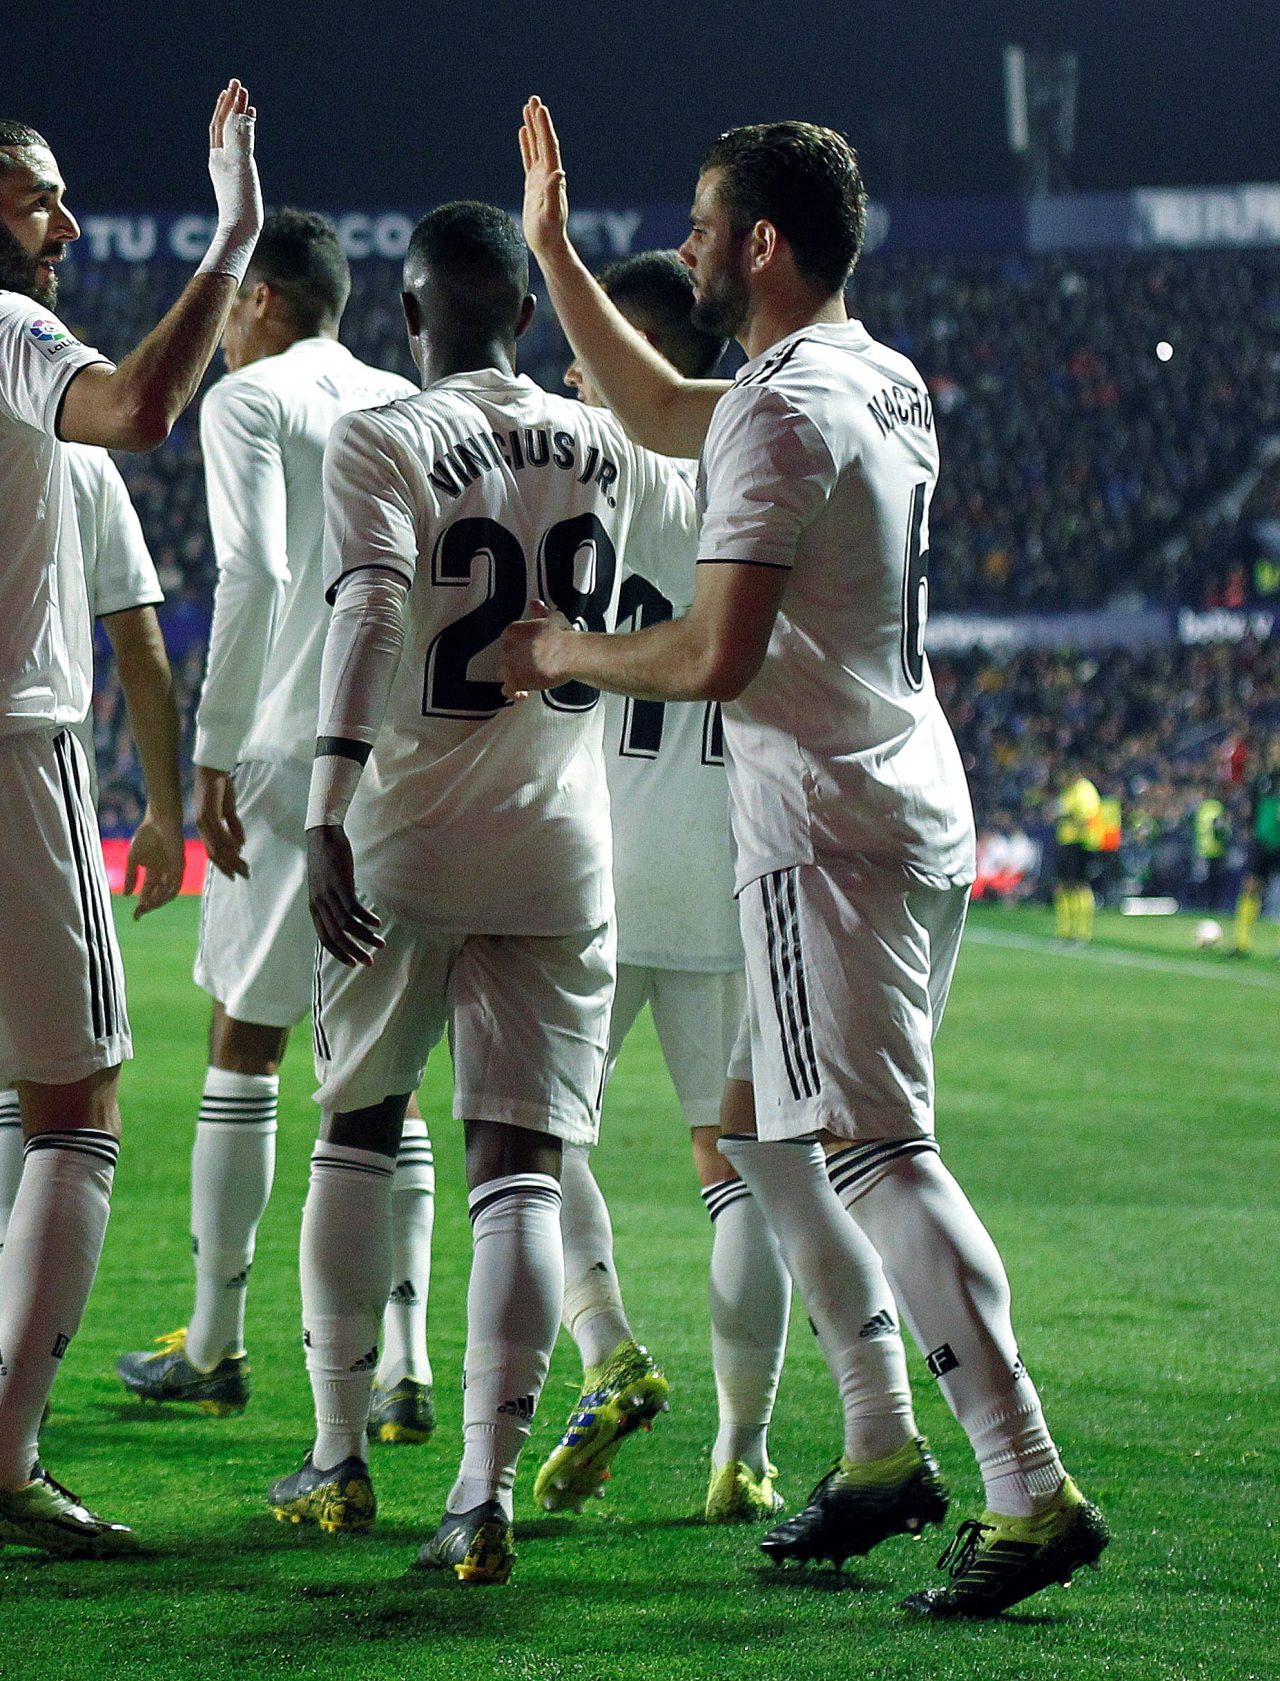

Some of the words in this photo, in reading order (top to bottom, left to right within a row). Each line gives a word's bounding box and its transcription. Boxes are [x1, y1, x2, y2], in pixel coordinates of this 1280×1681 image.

[84, 215, 157, 262] TU
[427, 428, 576, 499] VINICIUS
[577, 445, 618, 509] JR.
[422, 512, 617, 720] 28
